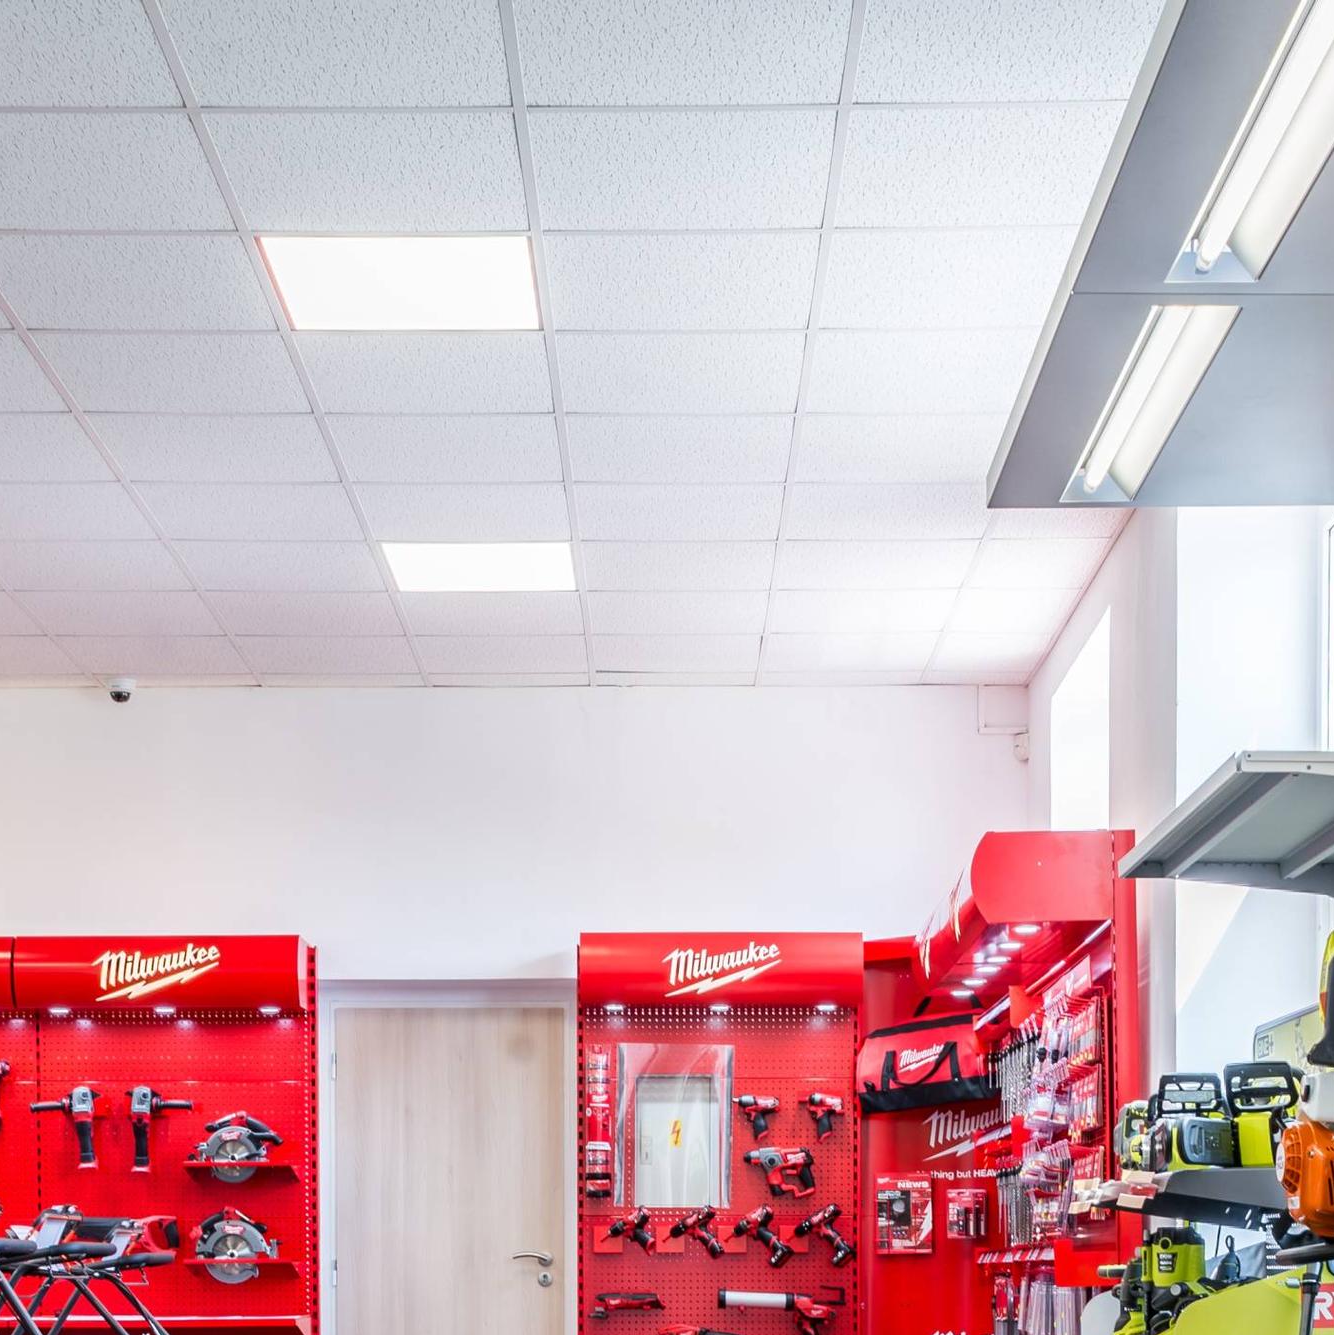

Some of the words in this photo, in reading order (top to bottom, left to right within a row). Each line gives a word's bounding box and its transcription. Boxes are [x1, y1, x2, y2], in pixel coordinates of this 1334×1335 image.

[91, 943, 221, 990] Milwaukee
[661, 941, 780, 986] Milwaukee
[897, 1181, 930, 1189] NEWS
[956, 1170, 972, 1179] but
